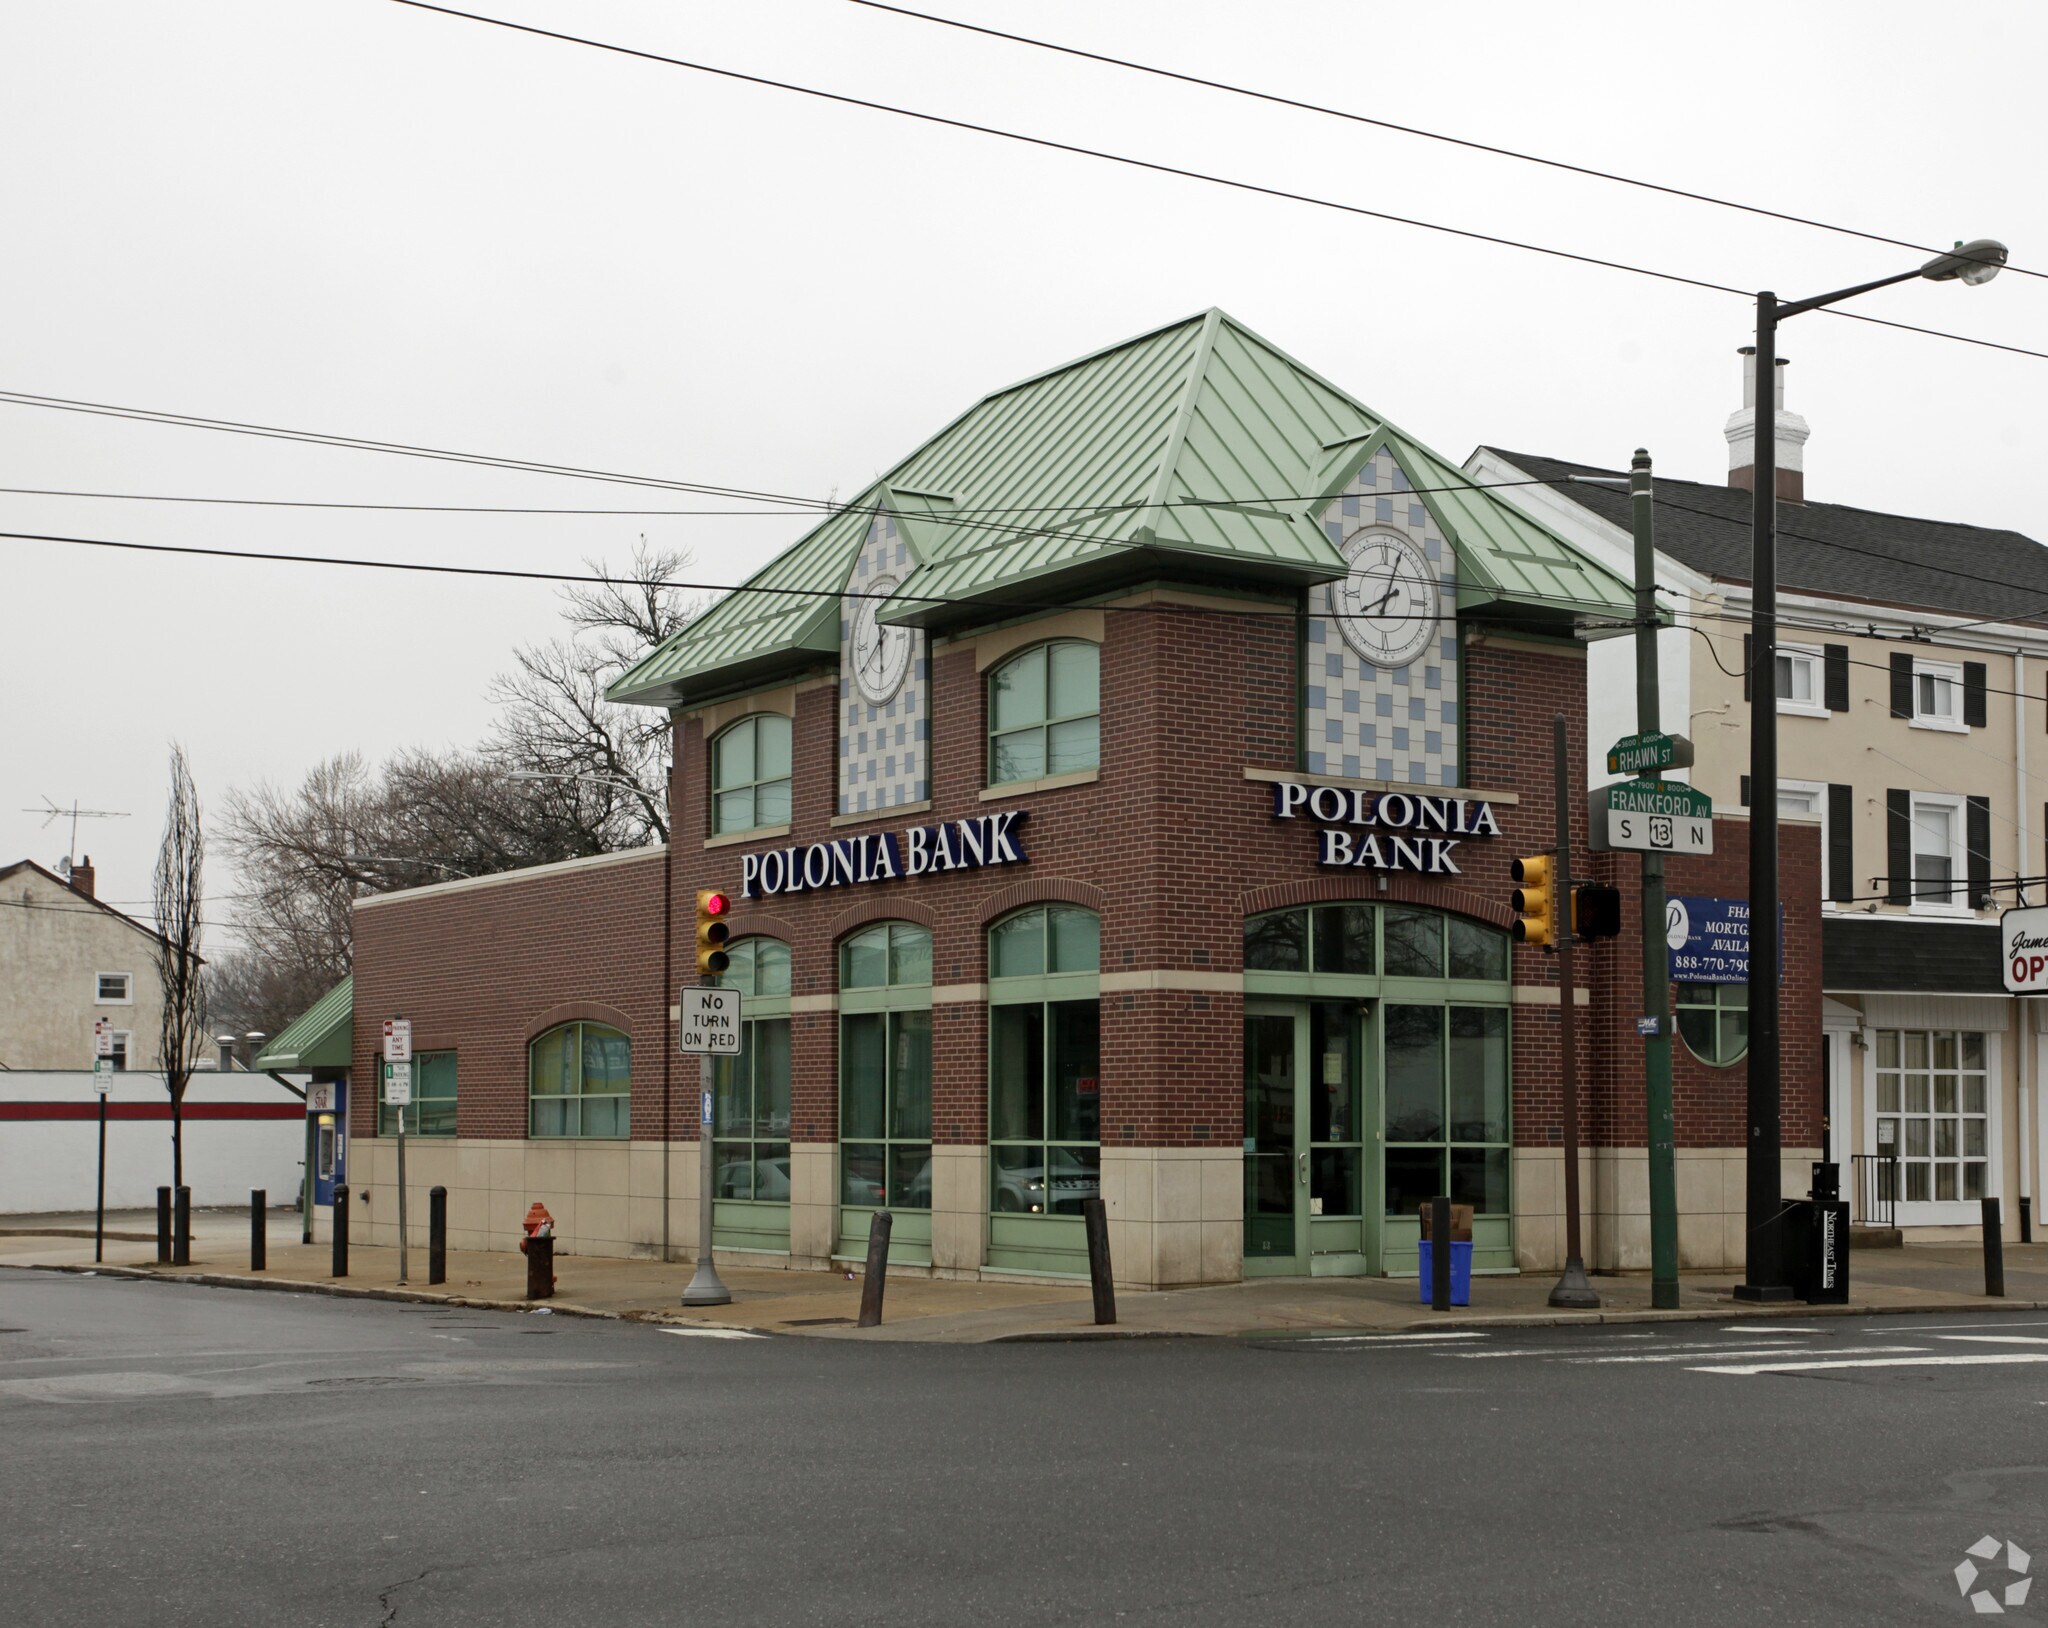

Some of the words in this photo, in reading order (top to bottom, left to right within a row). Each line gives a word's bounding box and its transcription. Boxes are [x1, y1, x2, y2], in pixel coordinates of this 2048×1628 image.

[1621, 739, 1637, 748] 3600
[1642, 735, 1659, 743] 4000
[1620, 746, 1658, 771] RHAWN
[1662, 749, 1671, 763] ST
[1637, 781, 1655, 789] 7900
[1667, 784, 1686, 792] 8000
[1277, 782, 1503, 836] POLONIA
[1611, 790, 1691, 816] FRANKFORD
[1696, 804, 1708, 818] AV
[1621, 819, 1632, 839] S
[1653, 824, 1670, 841] 13
[1691, 826, 1704, 845] N
[741, 832, 897, 898] POLONIA
[906, 811, 1020, 876] BANK
[1321, 829, 1462, 874] BANK
[1675, 956, 1749, 972] 888-770-790
[701, 996, 724, 1010] NO
[693, 1014, 730, 1028] TURN
[684, 1033, 702, 1045] ON
[710, 1033, 736, 1046] RED
[1827, 1211, 1838, 1261] NORTHEAST
[1827, 1262, 1837, 1289] TIMES
